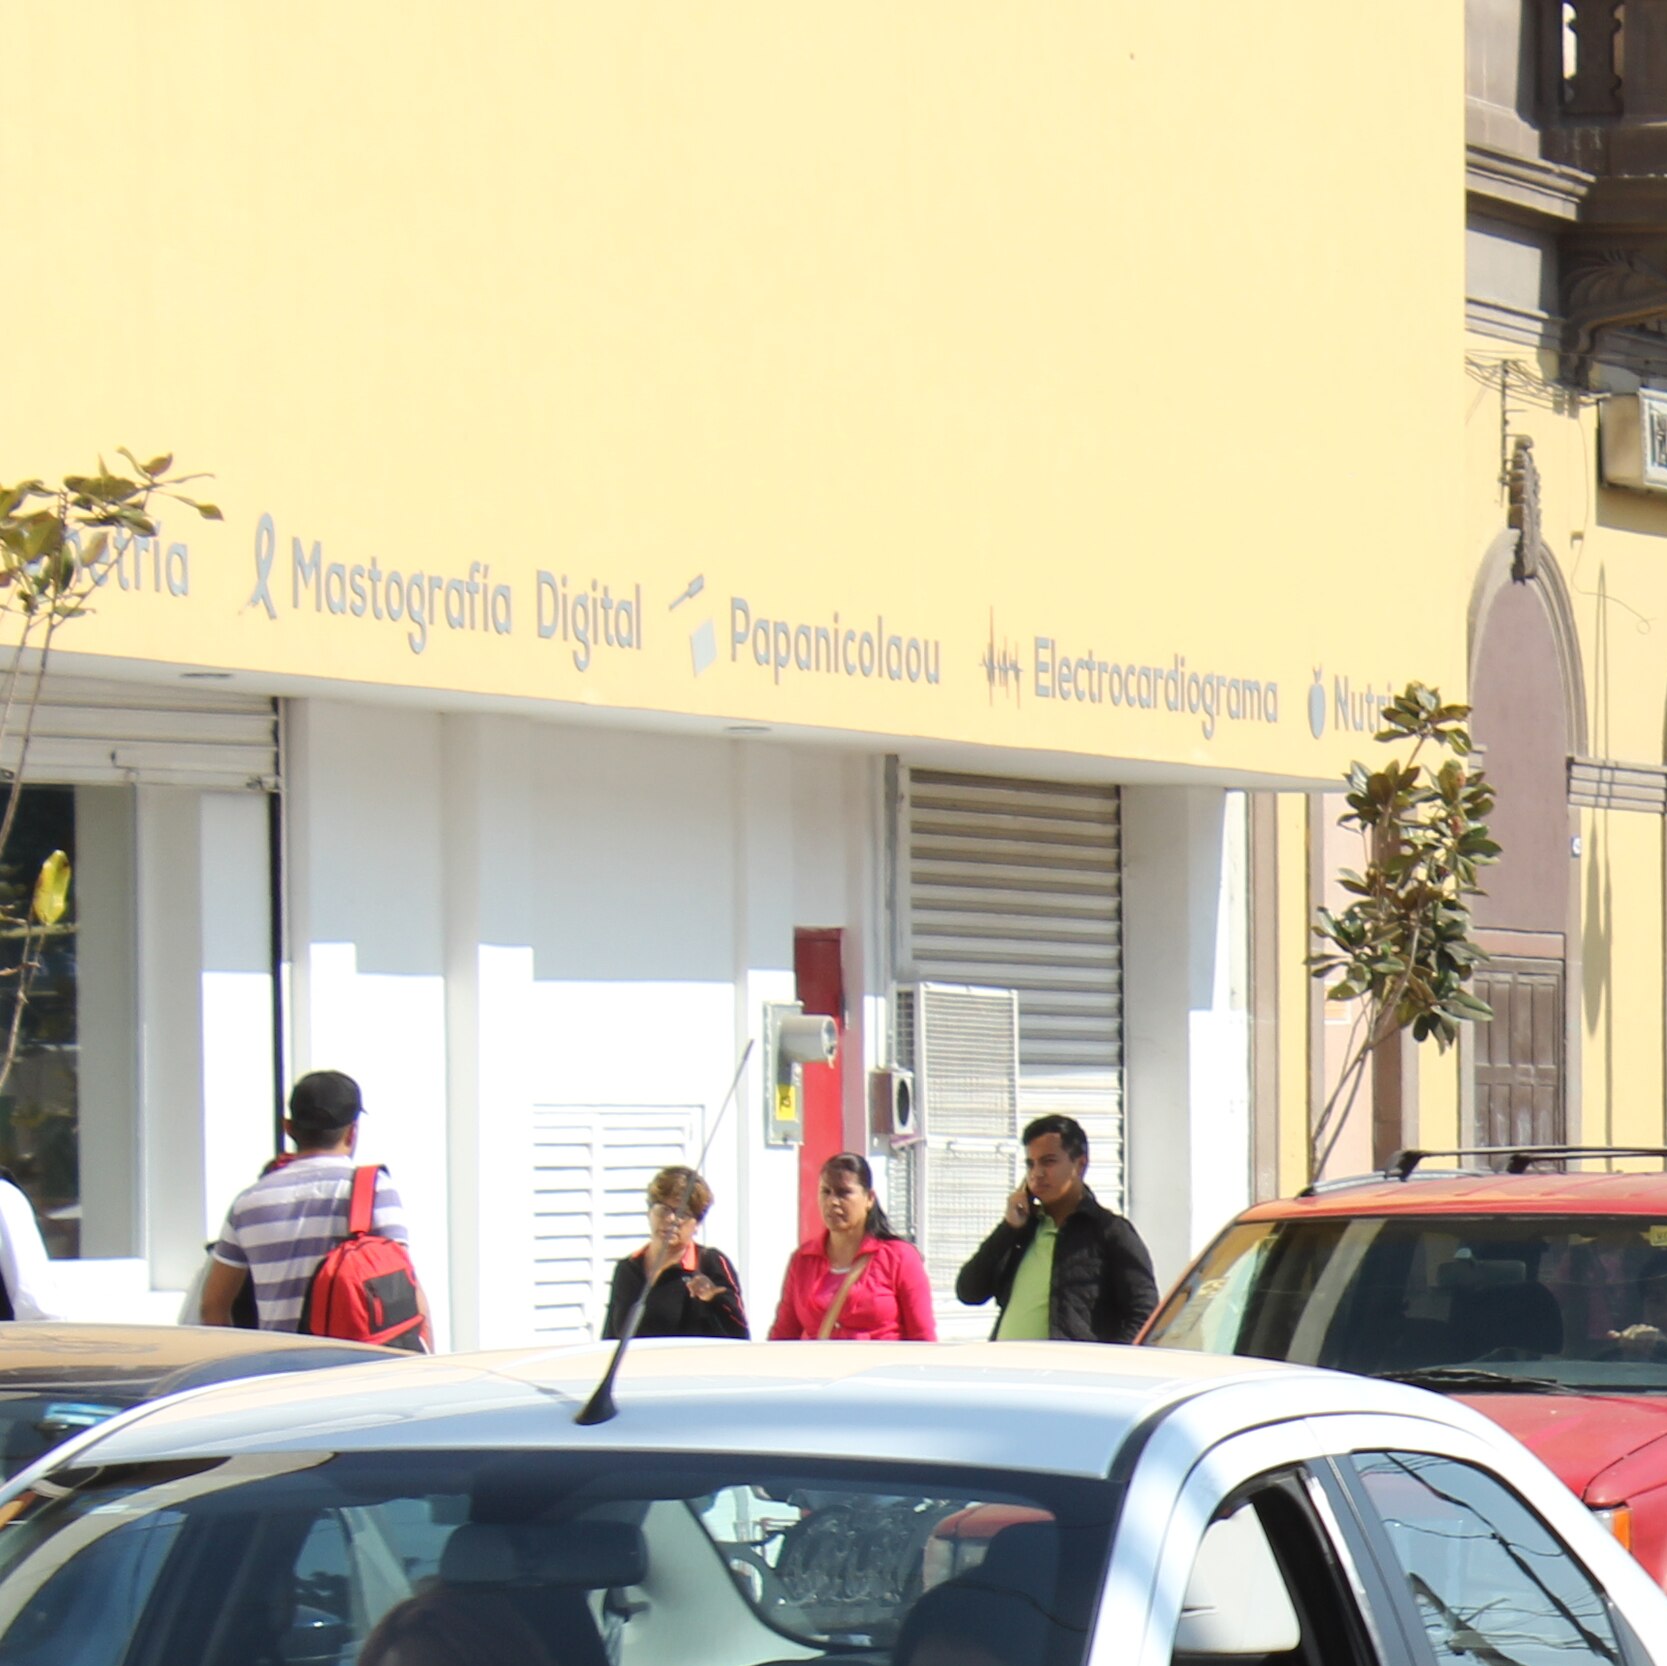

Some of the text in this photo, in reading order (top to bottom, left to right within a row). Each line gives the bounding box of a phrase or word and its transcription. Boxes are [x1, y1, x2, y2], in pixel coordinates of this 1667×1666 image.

[292, 536, 642, 672] Mastografía Digital
[730, 596, 940, 685] Papanicolaou
[1033, 635, 1279, 740] Electrocardiograma
